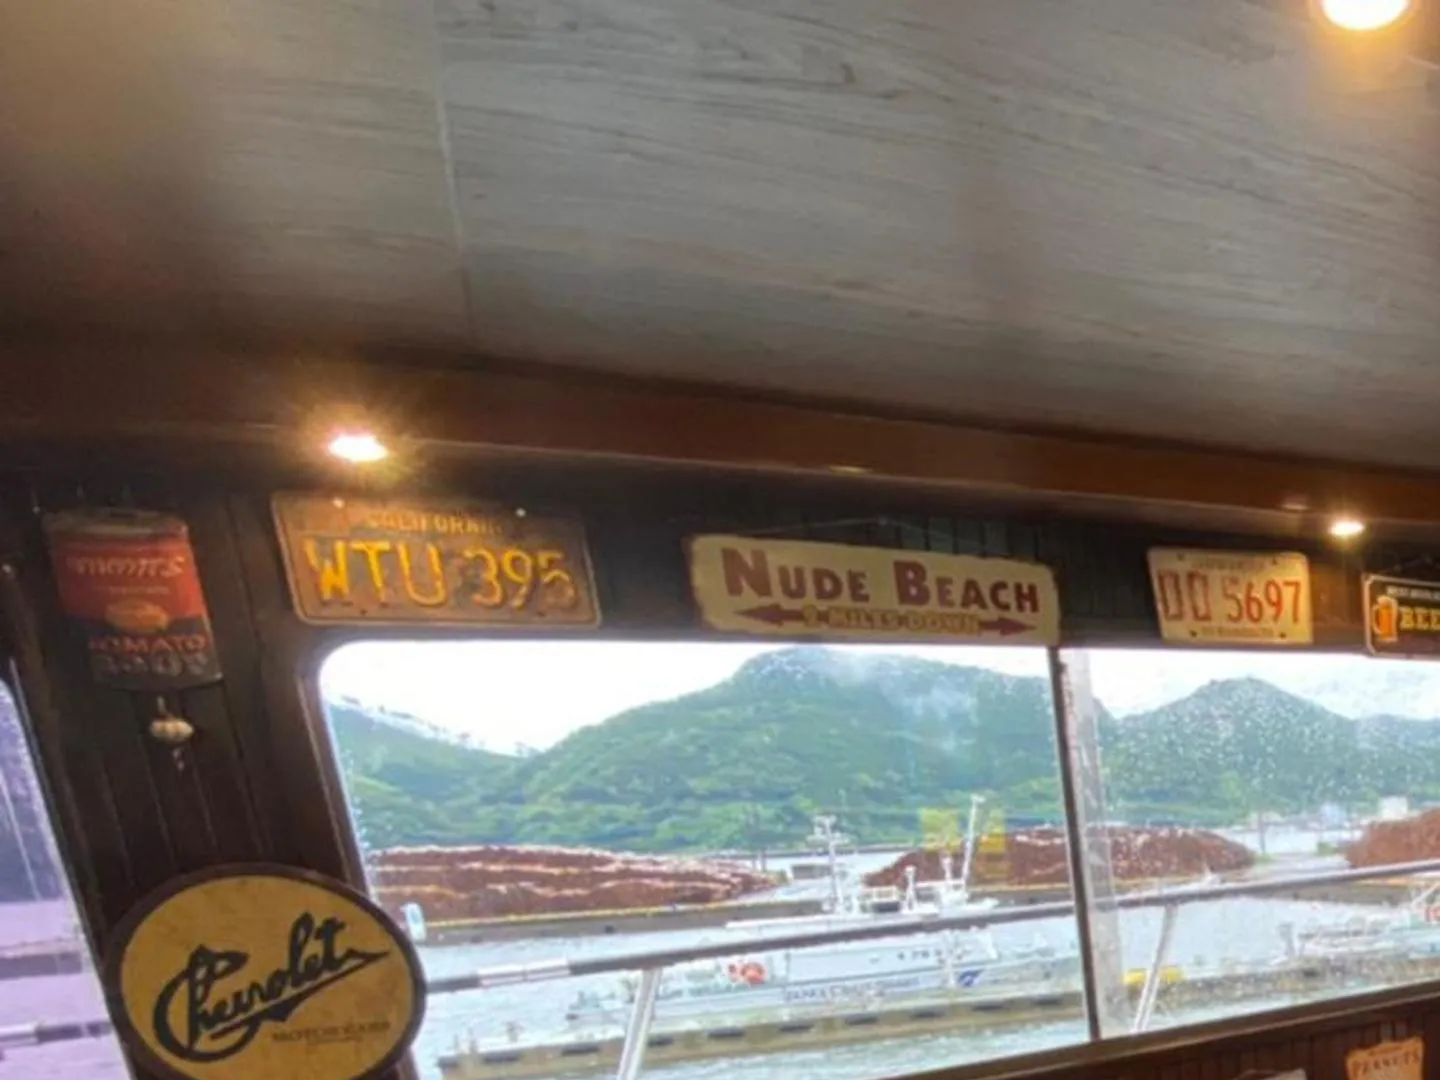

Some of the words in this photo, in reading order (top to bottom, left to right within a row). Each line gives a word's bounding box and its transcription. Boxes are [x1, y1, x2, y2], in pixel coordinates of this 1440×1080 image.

[303, 538, 447, 607] WTU
[463, 546, 578, 610] 395
[721, 547, 870, 603] NUDE
[893, 560, 1039, 613] BEACH
[1221, 575, 1301, 625] 5697
[153, 911, 390, 1063] Chevrolet
